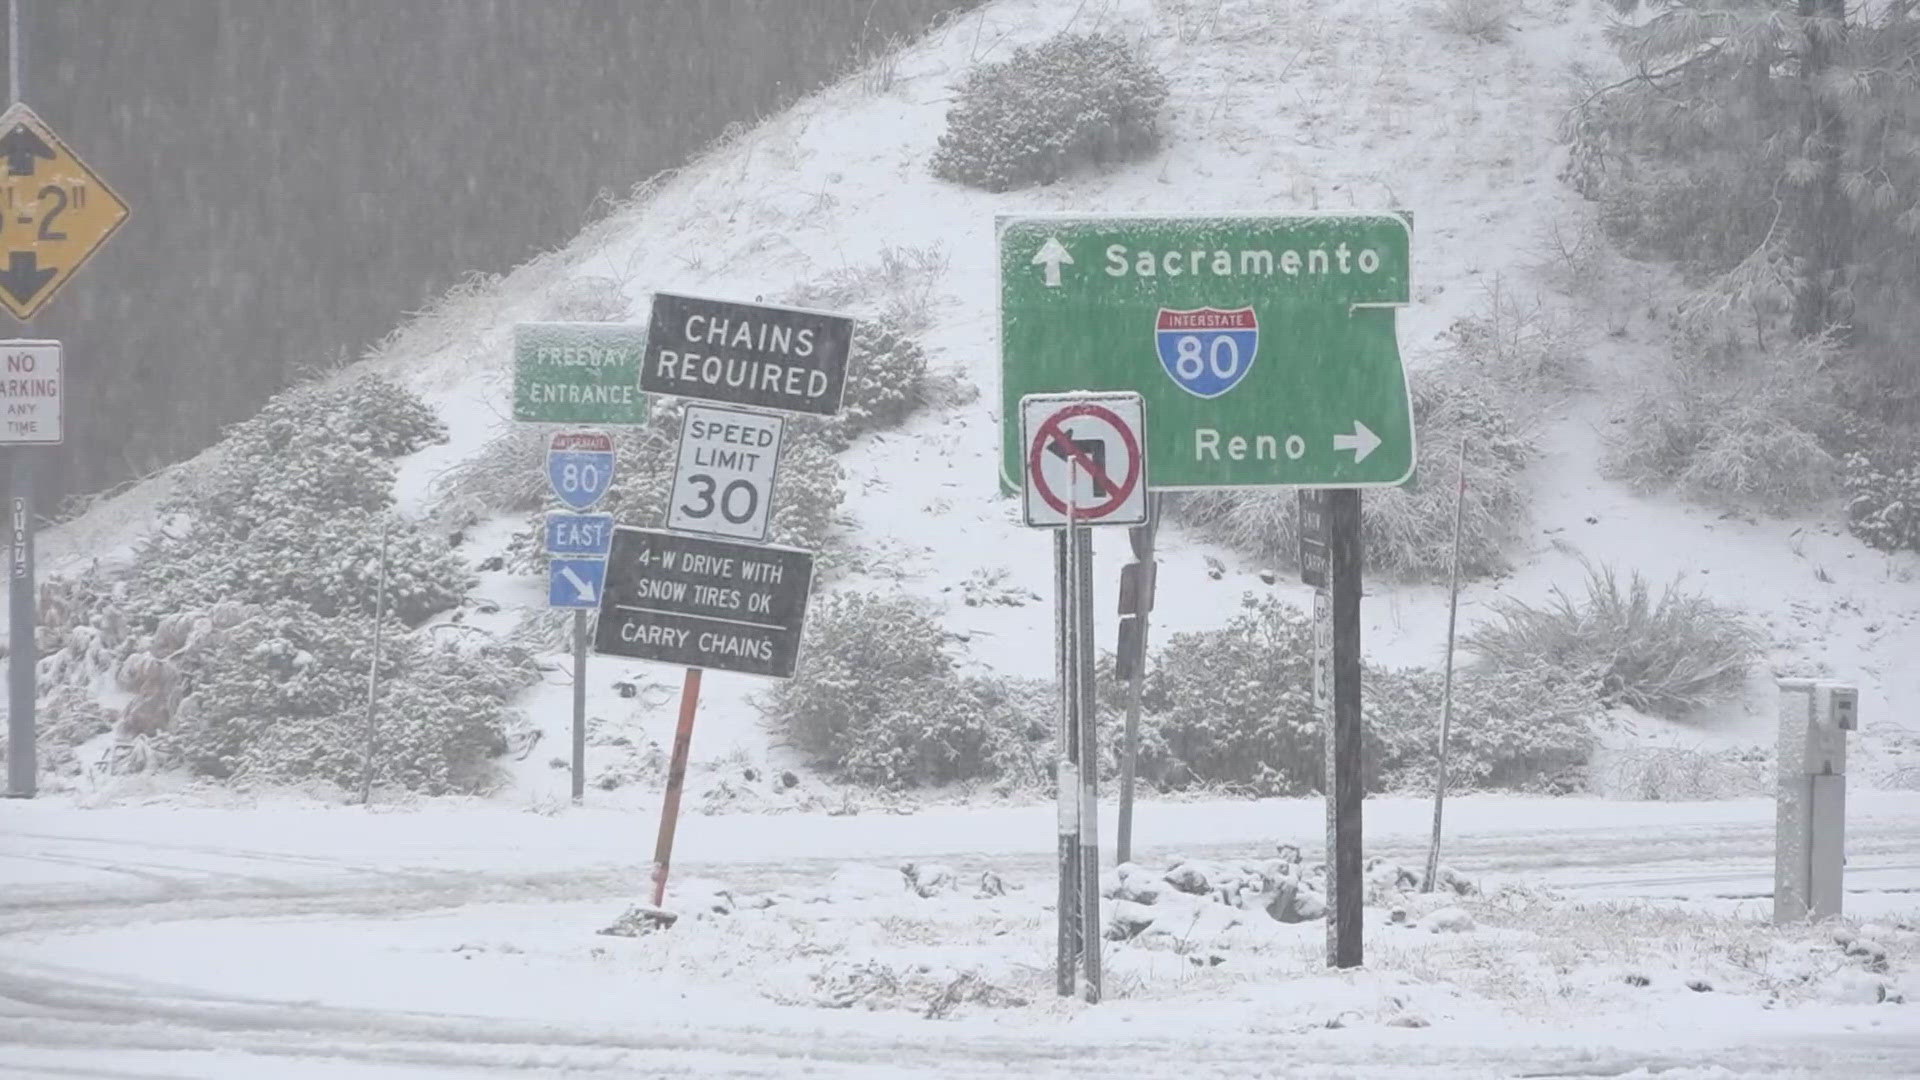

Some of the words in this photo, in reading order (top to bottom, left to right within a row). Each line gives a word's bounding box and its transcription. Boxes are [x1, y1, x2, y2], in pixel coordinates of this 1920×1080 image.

[0, 184, 85, 241] '-2"
[1105, 243, 1380, 277] Sacramento
[685, 315, 814, 356] CHAINS
[1169, 315, 1244, 327] INTERSTATE
[7, 354, 35, 373] NO
[1176, 335, 1239, 380] 80
[0, 379, 57, 397] ARKING
[657, 350, 828, 397] REQUIRED
[529, 382, 634, 404] ENTRANCE
[8, 404, 37, 415] ANY
[7, 420, 38, 433] TIME
[690, 420, 773, 448] SPEED
[694, 447, 760, 473] LIMIT
[1195, 428, 1305, 461] Reno
[562, 463, 599, 493] 80
[680, 473, 758, 524] 30
[556, 523, 604, 547] EAST
[639, 548, 676, 570] 4-W
[681, 553, 733, 578] DRIVE
[741, 560, 783, 585] WITH
[637, 578, 687, 603] SNOW
[694, 584, 741, 609] TIRES
[748, 592, 772, 614] OK
[621, 622, 690, 648] CARRY
[699, 632, 773, 661] CHAINS
